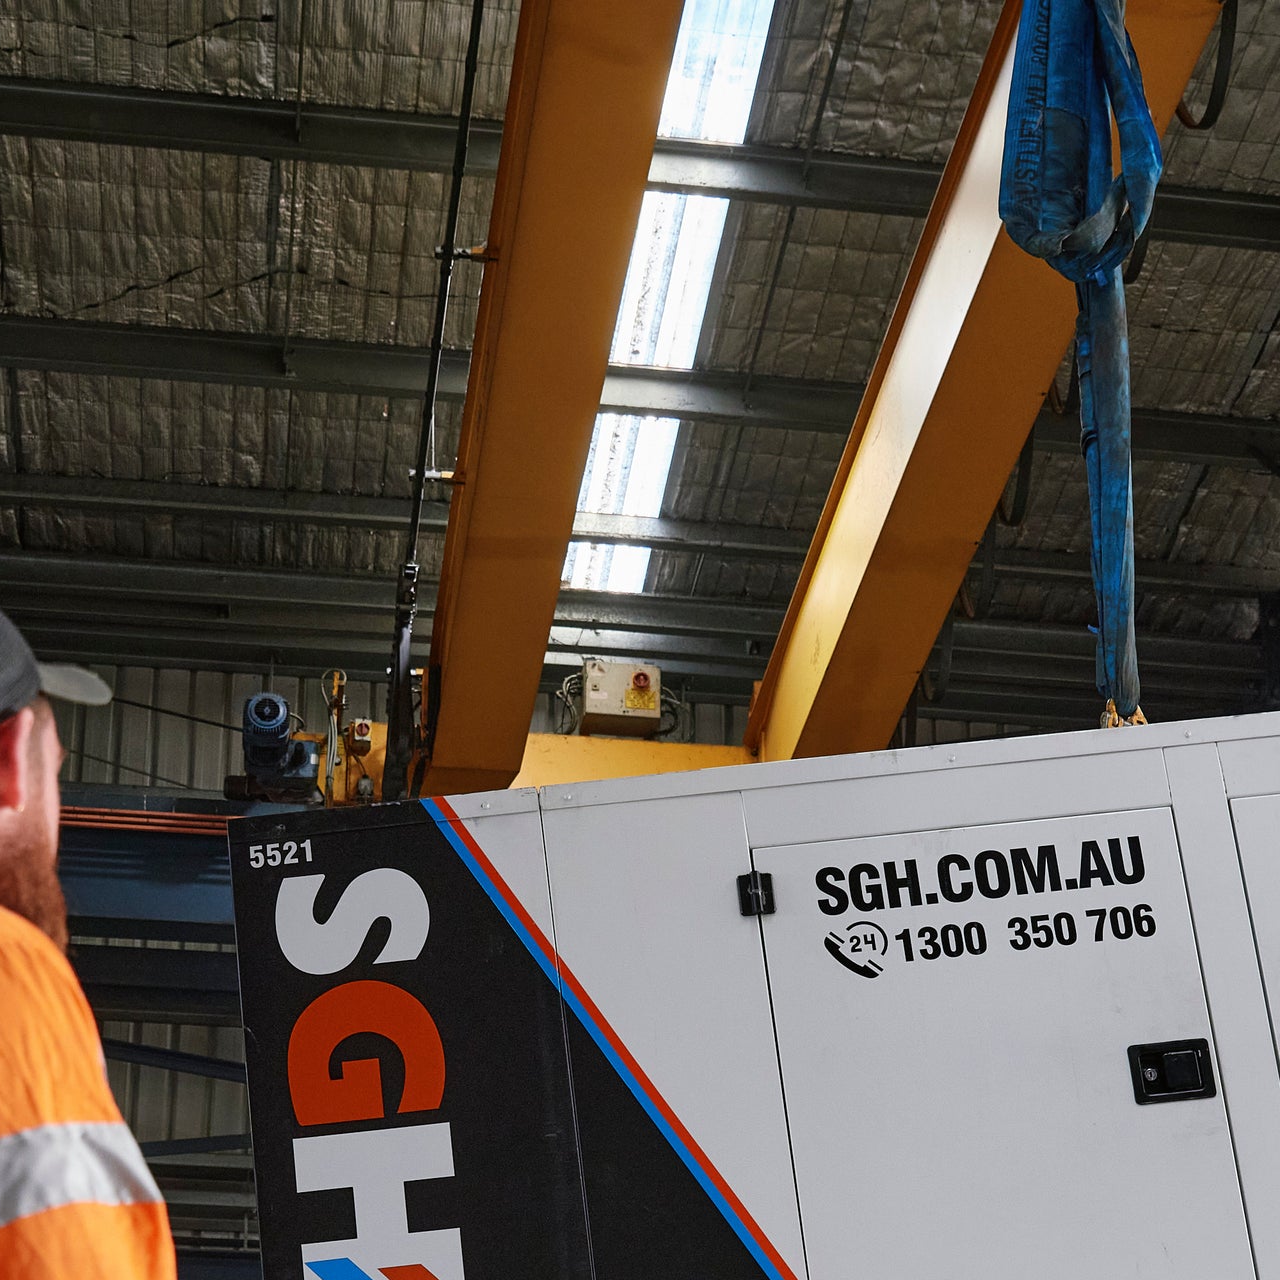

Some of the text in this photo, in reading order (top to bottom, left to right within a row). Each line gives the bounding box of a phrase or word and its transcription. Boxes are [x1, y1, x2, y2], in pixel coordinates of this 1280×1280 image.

[249, 839, 313, 869] 5521
[814, 835, 1146, 916] SGH.COM.AU
[849, 933, 878, 953] 24
[894, 903, 1157, 962] 1300 350 706
